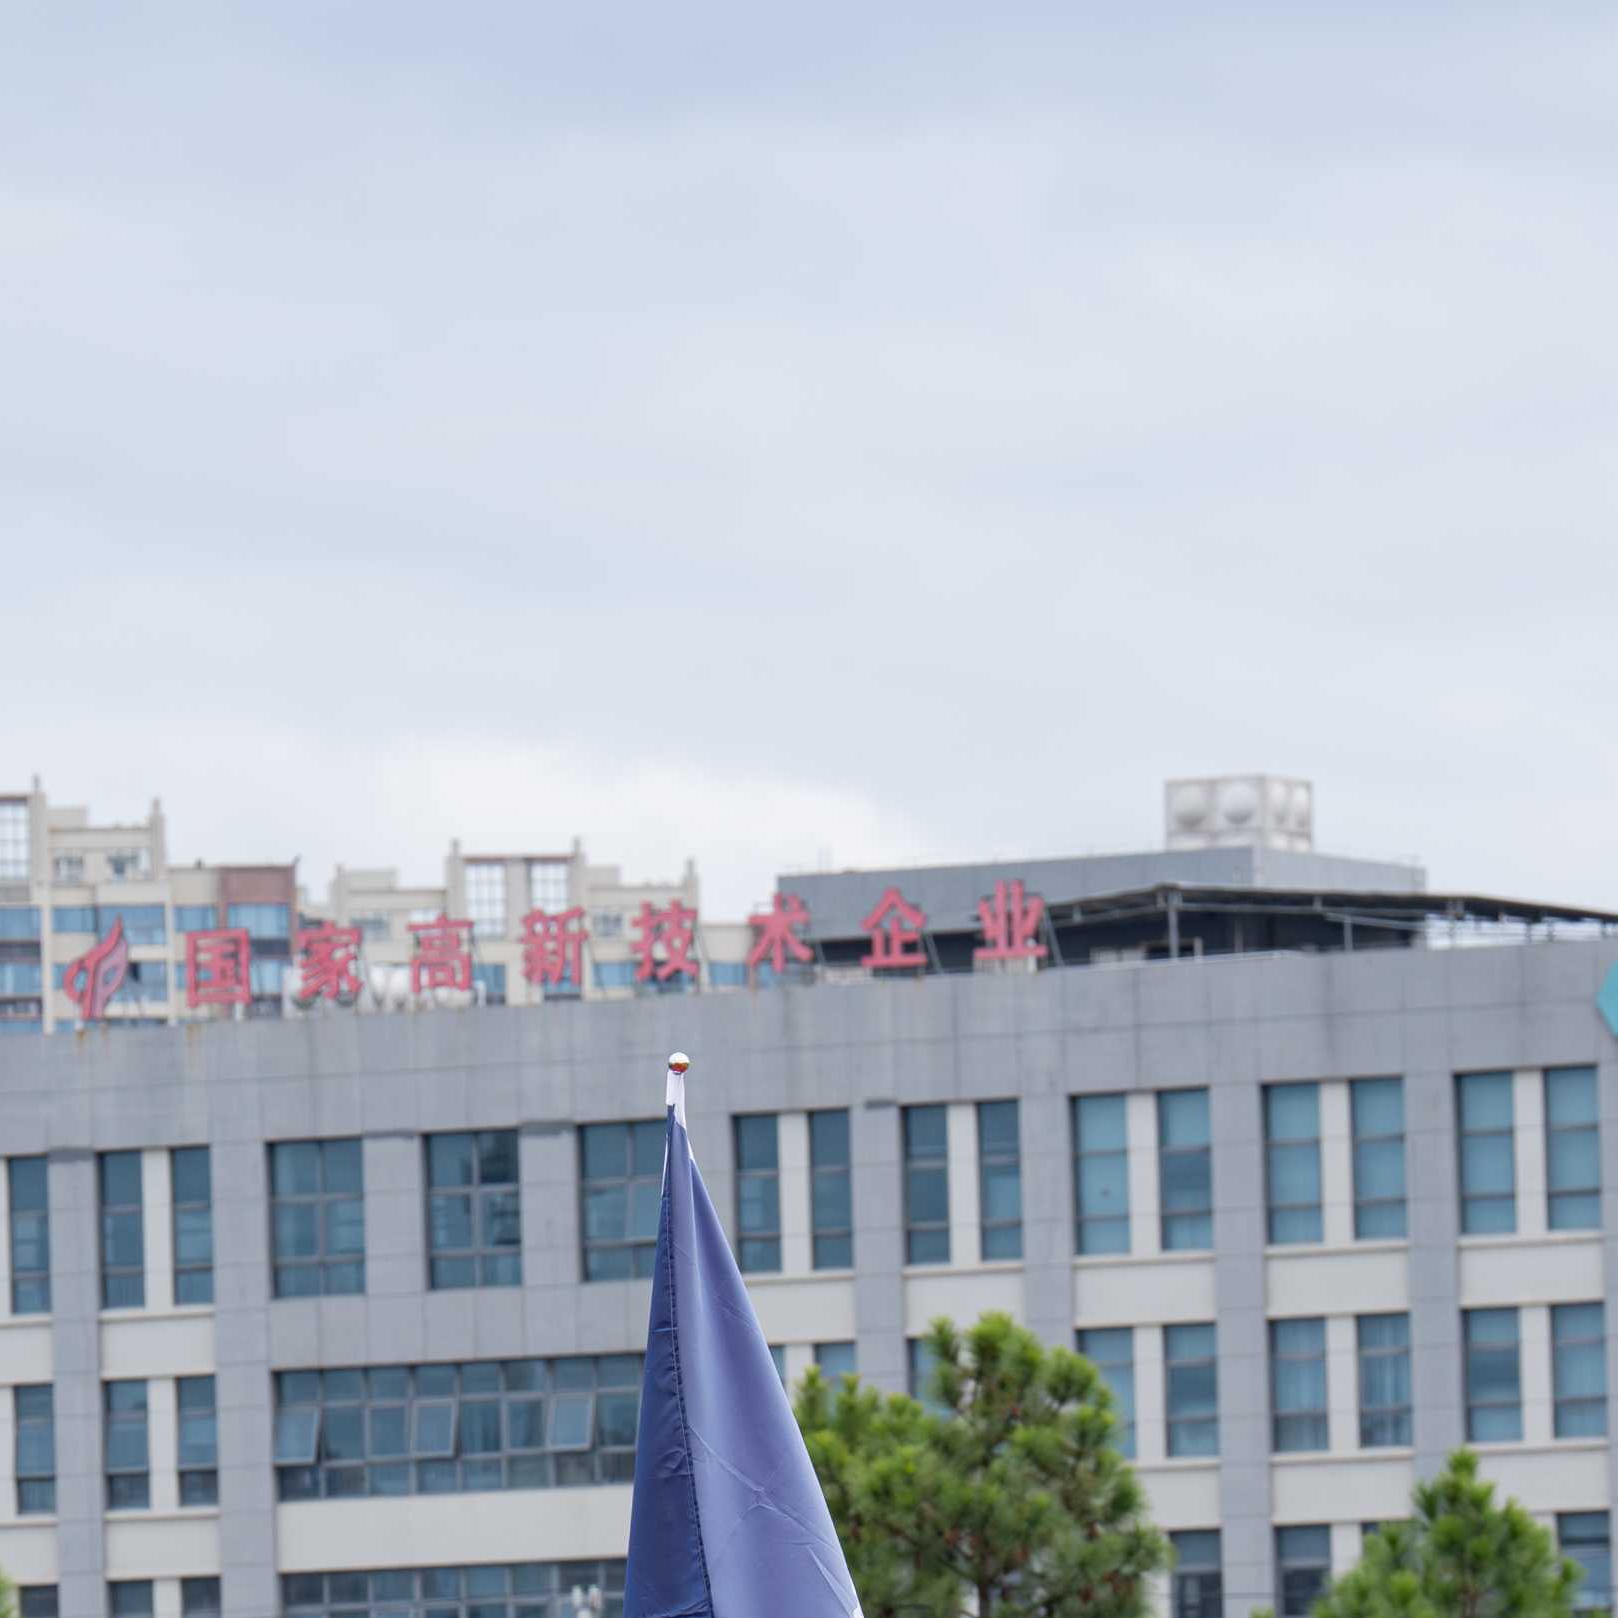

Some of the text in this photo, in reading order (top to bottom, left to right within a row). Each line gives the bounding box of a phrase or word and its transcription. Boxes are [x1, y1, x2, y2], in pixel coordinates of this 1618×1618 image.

[184, 879, 1049, 1008] 国家高新技术企业
